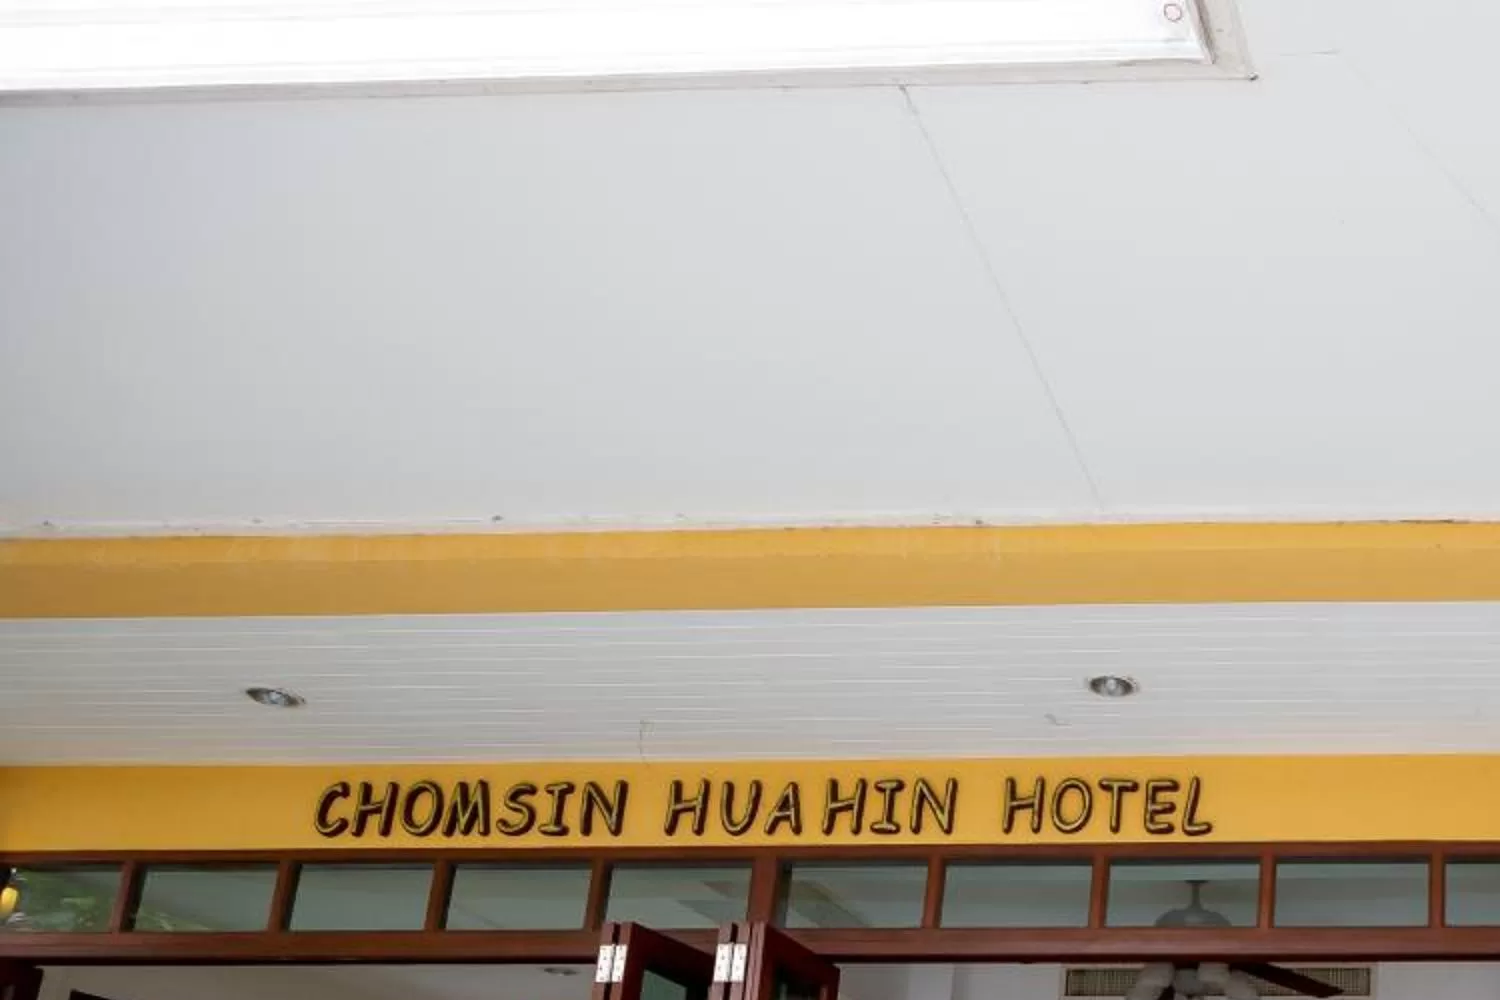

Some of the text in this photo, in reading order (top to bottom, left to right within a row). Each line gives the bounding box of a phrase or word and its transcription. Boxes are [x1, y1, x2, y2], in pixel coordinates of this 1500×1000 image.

[314, 777, 1214, 838] CHOMSIN HUA HIN HOTEL
